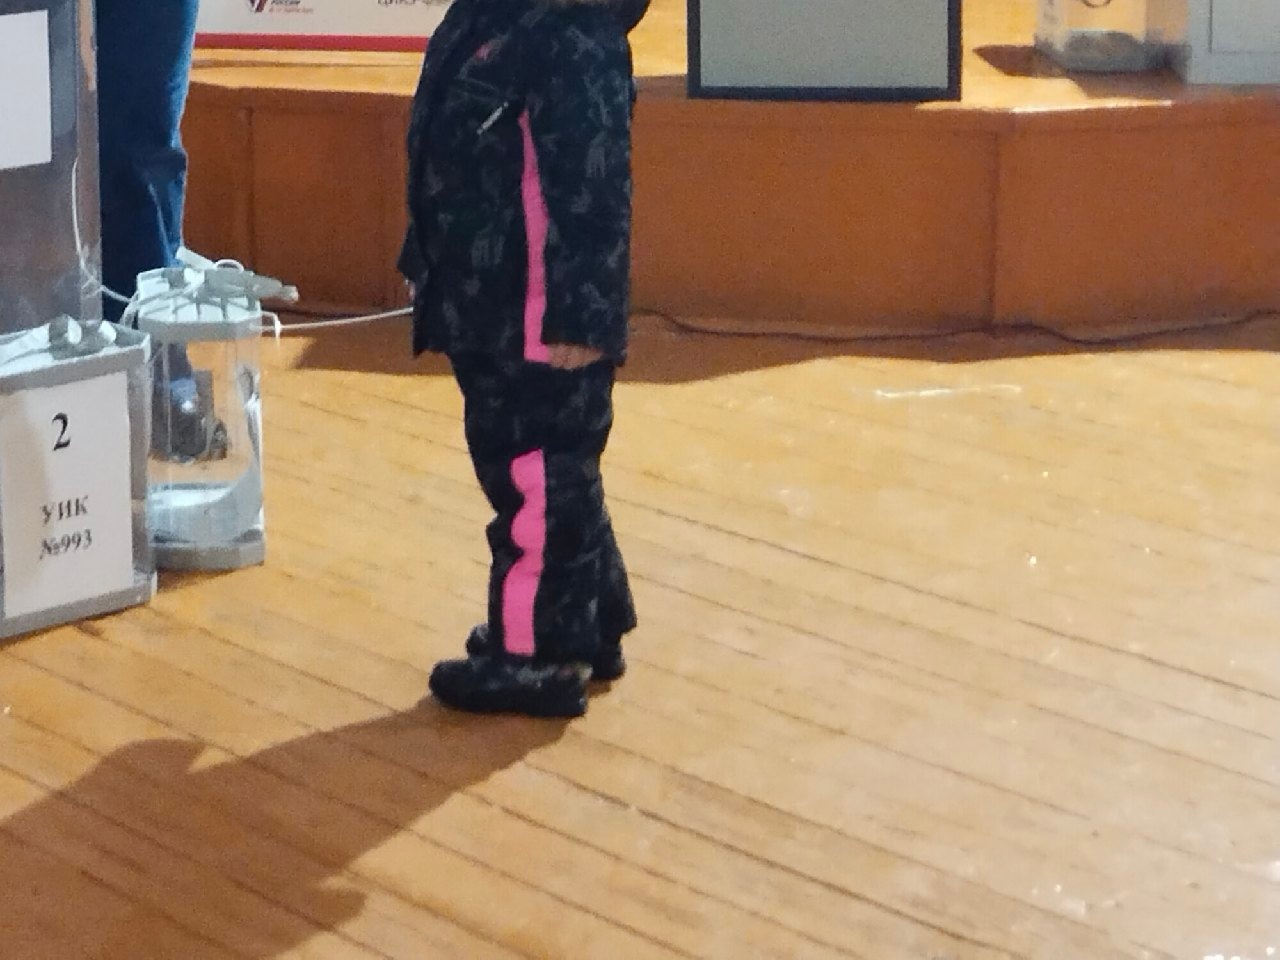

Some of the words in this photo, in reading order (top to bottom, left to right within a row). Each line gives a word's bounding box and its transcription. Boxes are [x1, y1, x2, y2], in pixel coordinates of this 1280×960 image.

[52, 412, 71, 451] 2
[40, 495, 89, 525] УИК
[39, 529, 93, 560] №993
